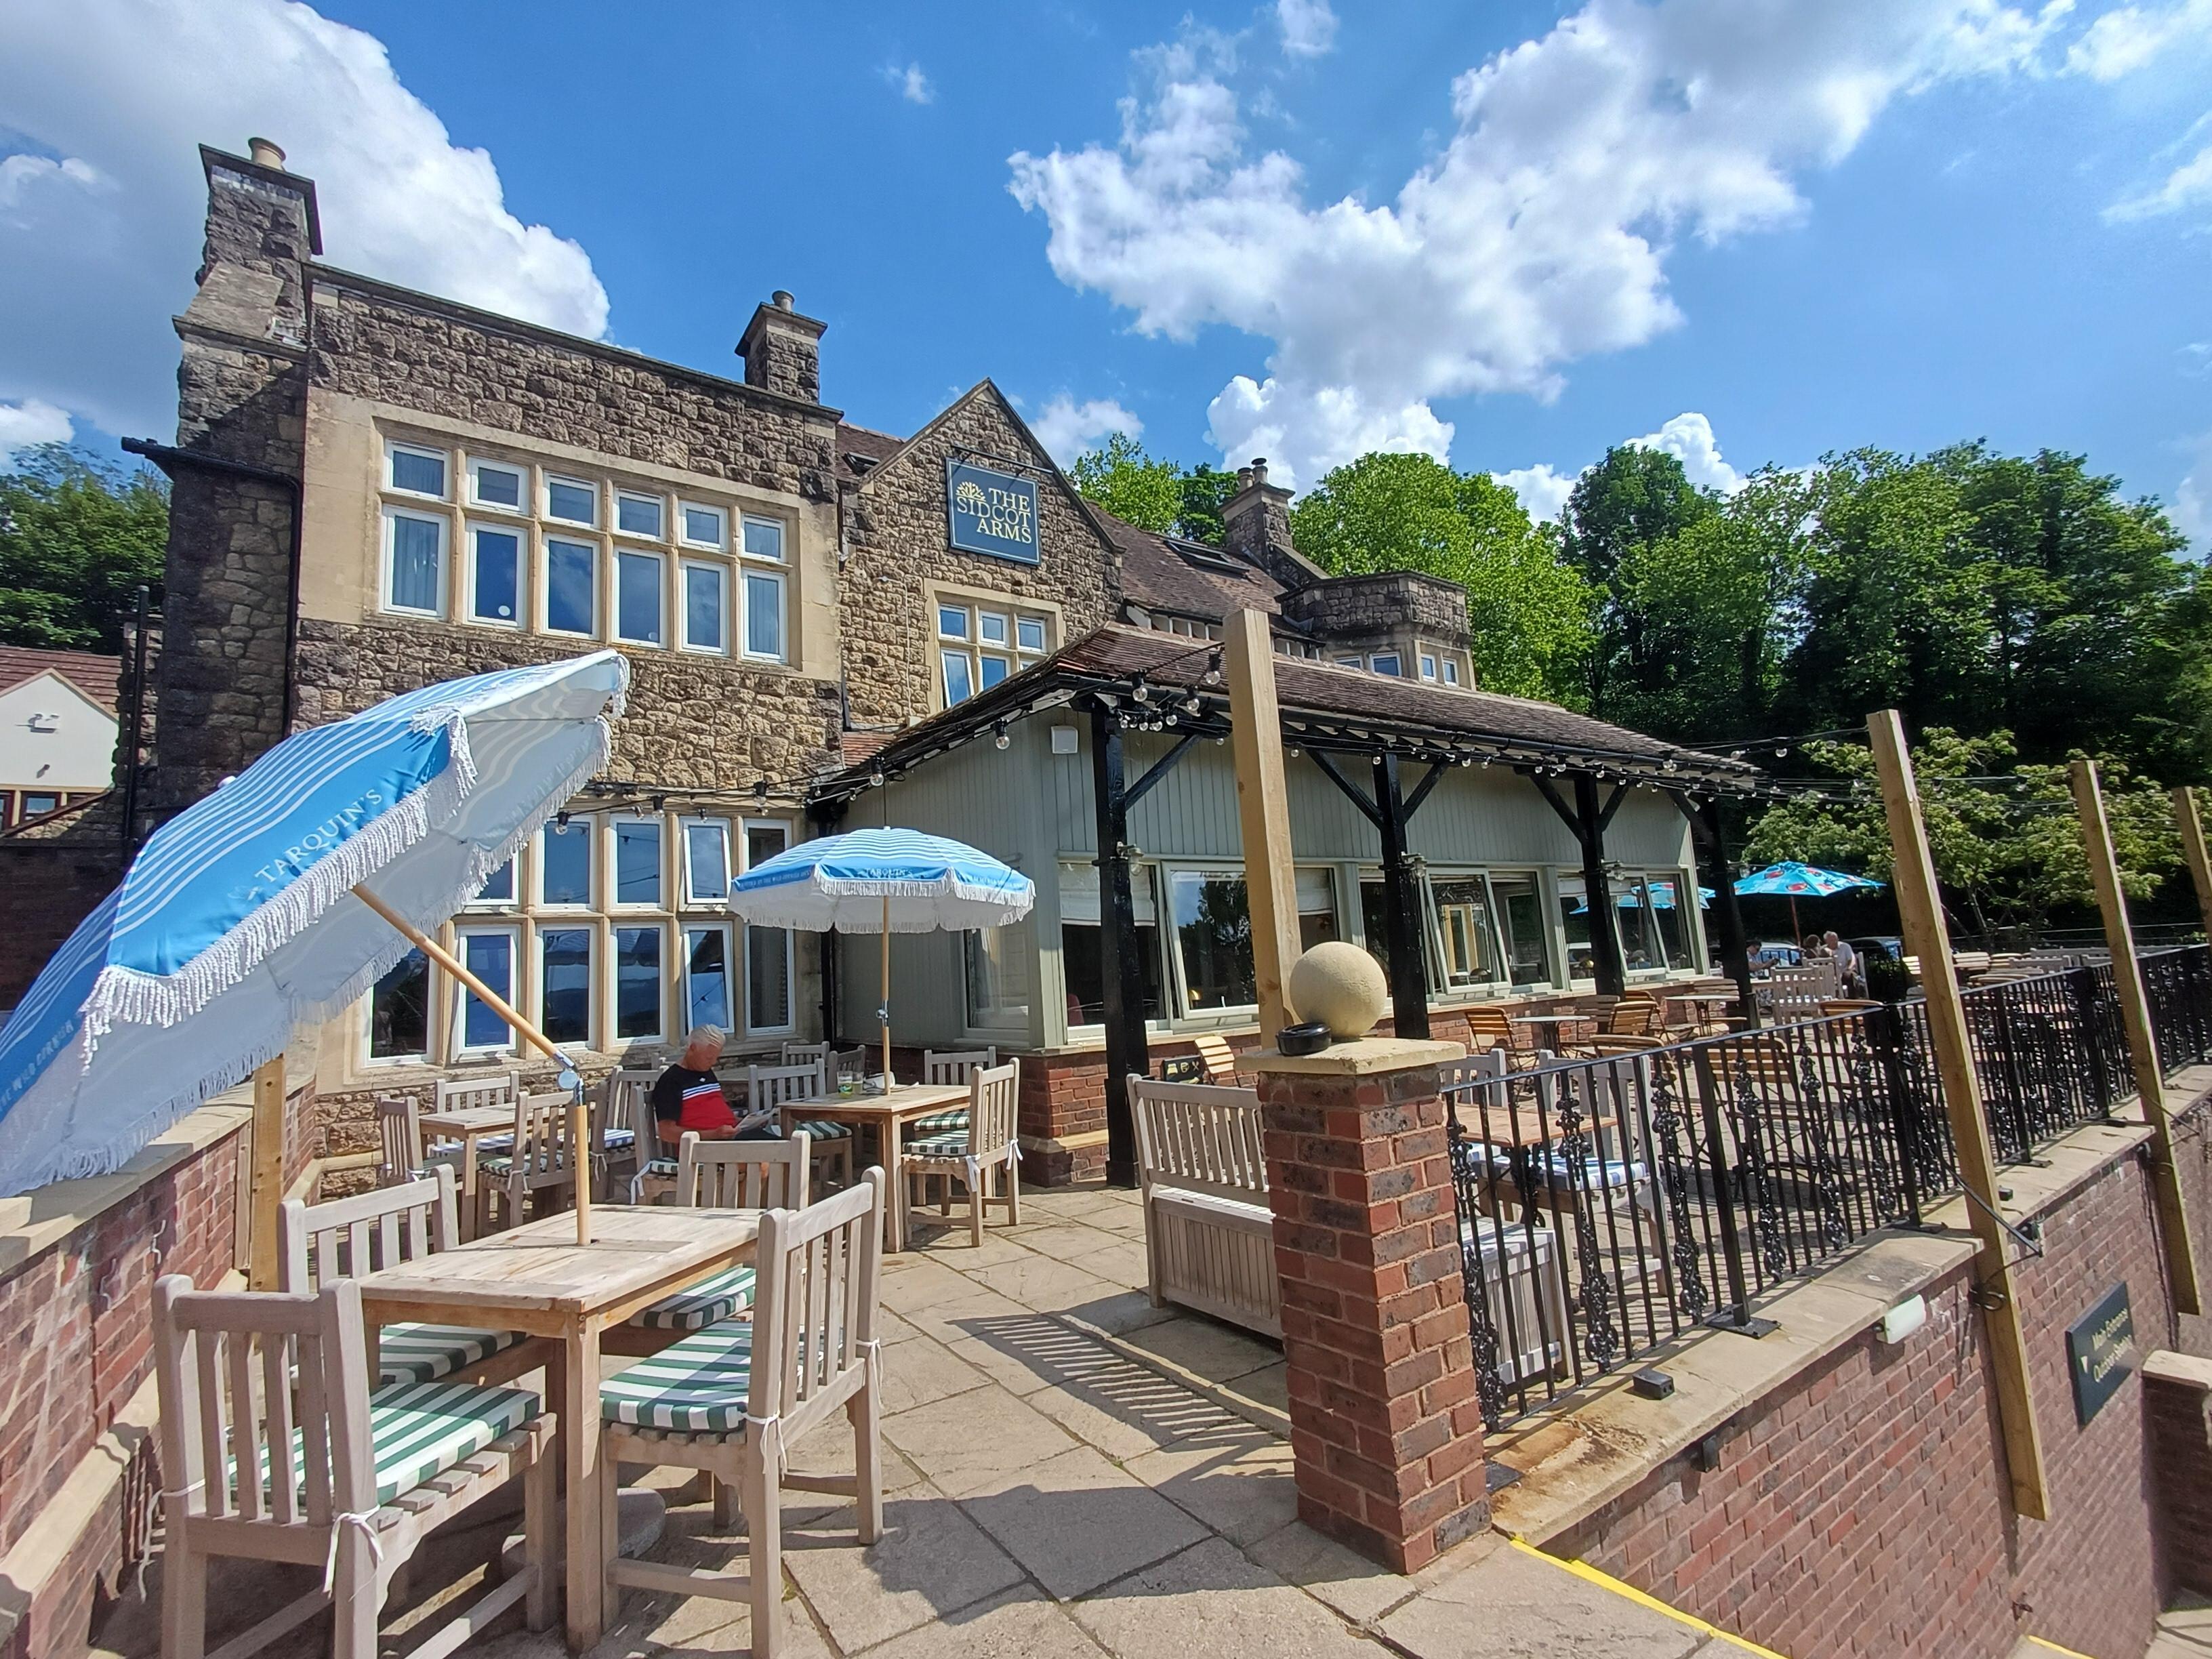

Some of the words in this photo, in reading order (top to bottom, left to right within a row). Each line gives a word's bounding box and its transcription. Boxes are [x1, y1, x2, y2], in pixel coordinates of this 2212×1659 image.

[956, 496, 1031, 528] SIDCOT
[988, 487, 1030, 512] THE
[976, 518, 1032, 544] ARMS
[254, 789, 382, 882] TARQUIN'S
